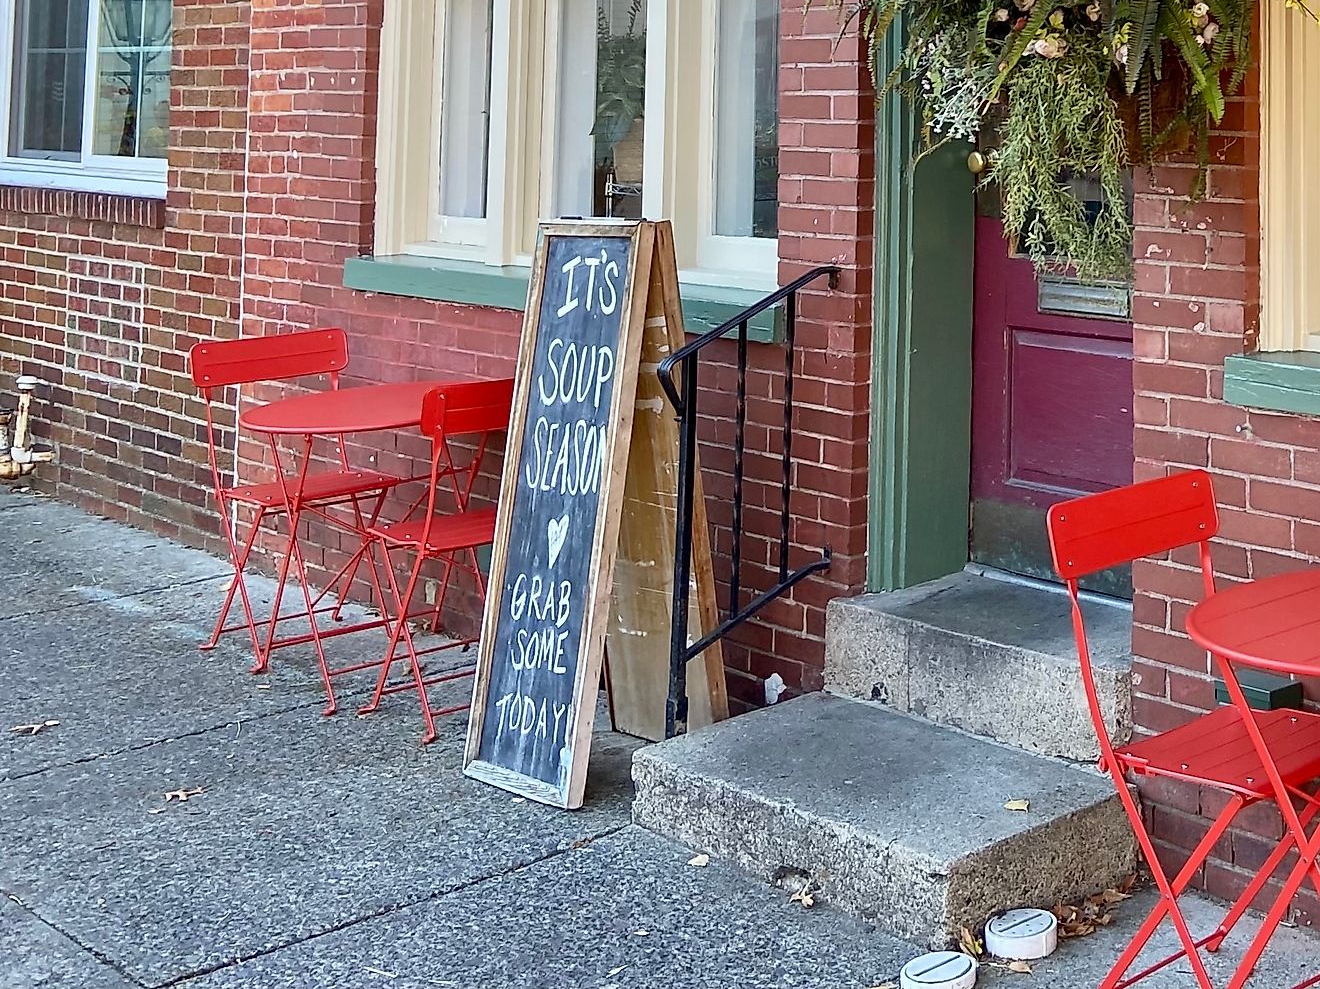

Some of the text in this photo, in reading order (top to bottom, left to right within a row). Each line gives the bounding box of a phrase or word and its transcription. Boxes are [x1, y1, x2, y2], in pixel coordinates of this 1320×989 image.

[556, 248, 620, 318] IT'S
[537, 337, 615, 409] SOUP
[510, 572, 572, 629] GRAB
[510, 628, 570, 675] SOME
